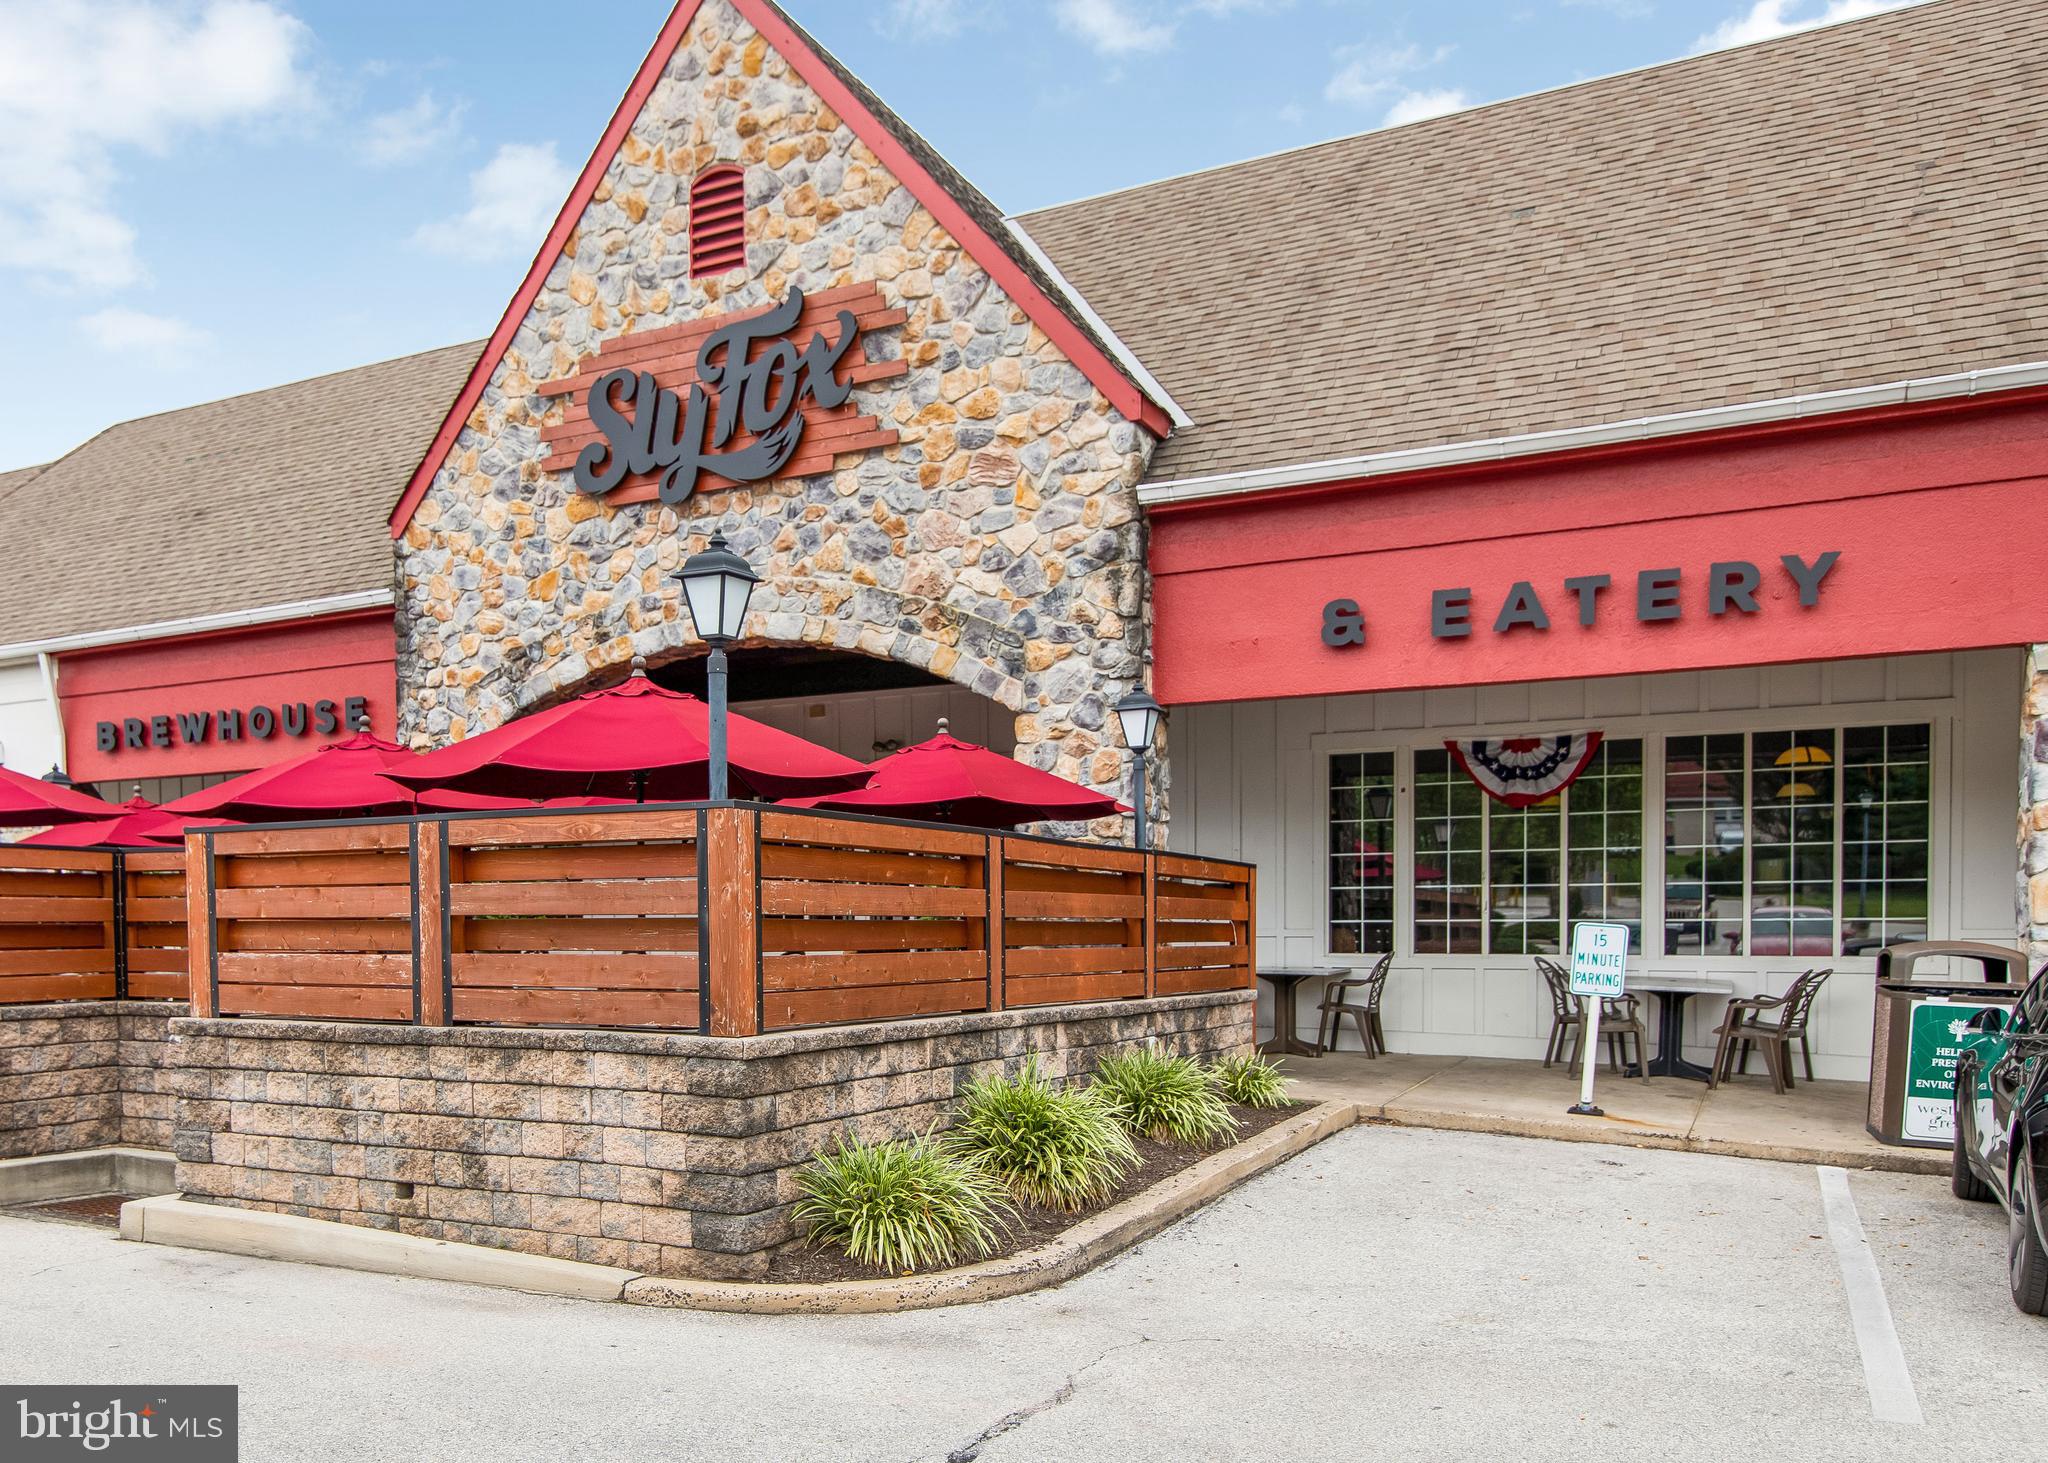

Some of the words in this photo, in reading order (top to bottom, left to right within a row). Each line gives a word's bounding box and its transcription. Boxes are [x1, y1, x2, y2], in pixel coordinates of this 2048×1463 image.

[573, 367, 806, 505] Sly
[696, 285, 858, 449] Fox
[1321, 598, 1365, 647] &
[1431, 551, 1842, 638] EATERY
[96, 696, 368, 752] BREWHOUSE
[1594, 934, 1607, 947] 15
[1577, 952, 1621, 967] MINUTE
[1574, 971, 1619, 987] PARKING
[1931, 1058, 1957, 1067] PRES
